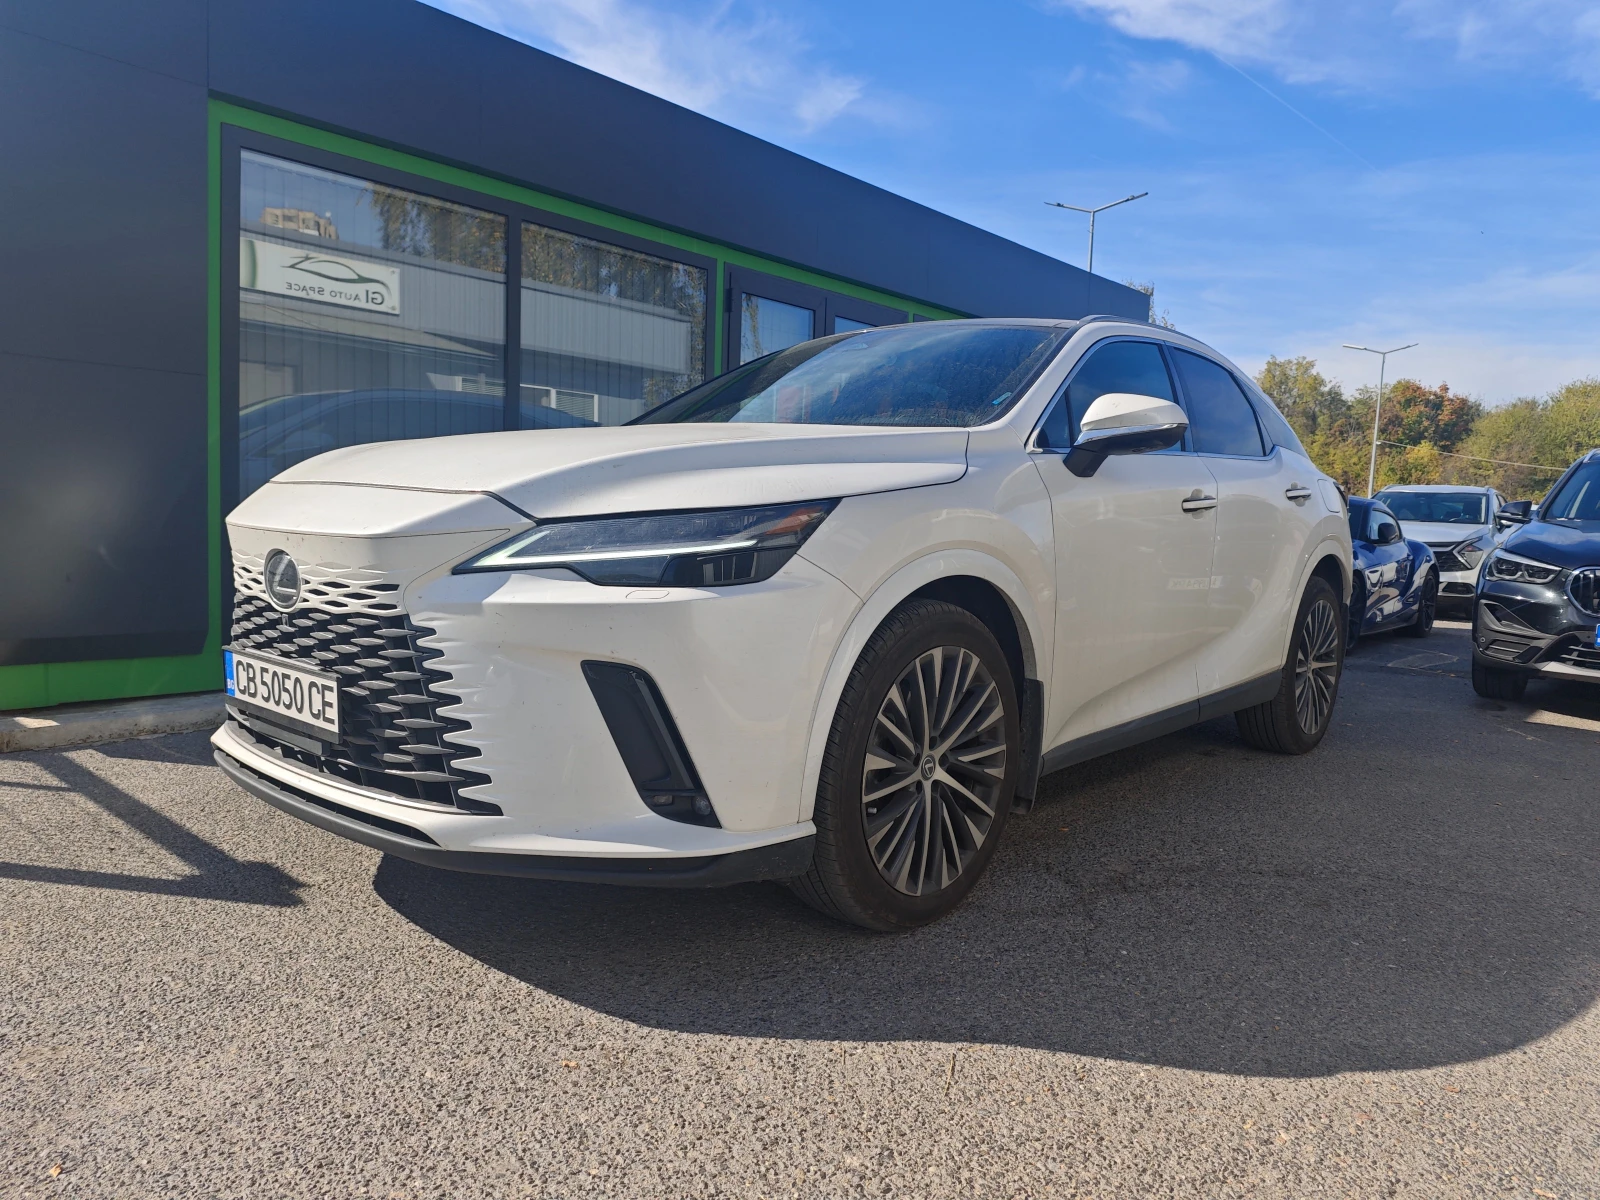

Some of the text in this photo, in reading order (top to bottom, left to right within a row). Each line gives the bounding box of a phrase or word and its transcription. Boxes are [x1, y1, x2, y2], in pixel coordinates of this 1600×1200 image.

[227, 678, 235, 690] BG
[235, 659, 336, 726] CB 5050 CE
